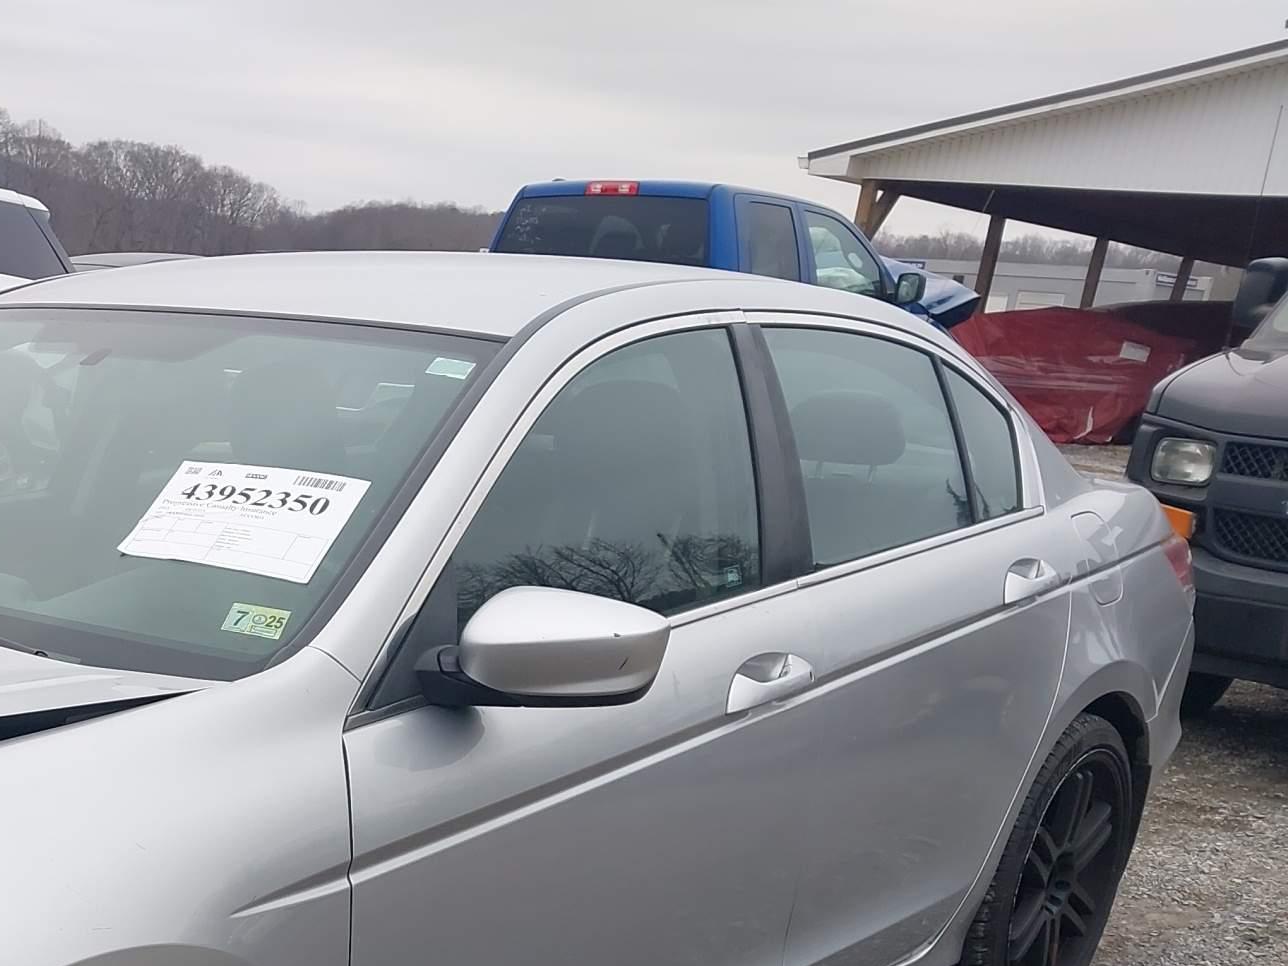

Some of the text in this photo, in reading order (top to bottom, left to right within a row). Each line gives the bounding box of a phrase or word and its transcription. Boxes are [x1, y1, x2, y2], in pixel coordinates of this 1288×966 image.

[180, 482, 331, 516] 43952350
[233, 610, 286, 629] 7 25
